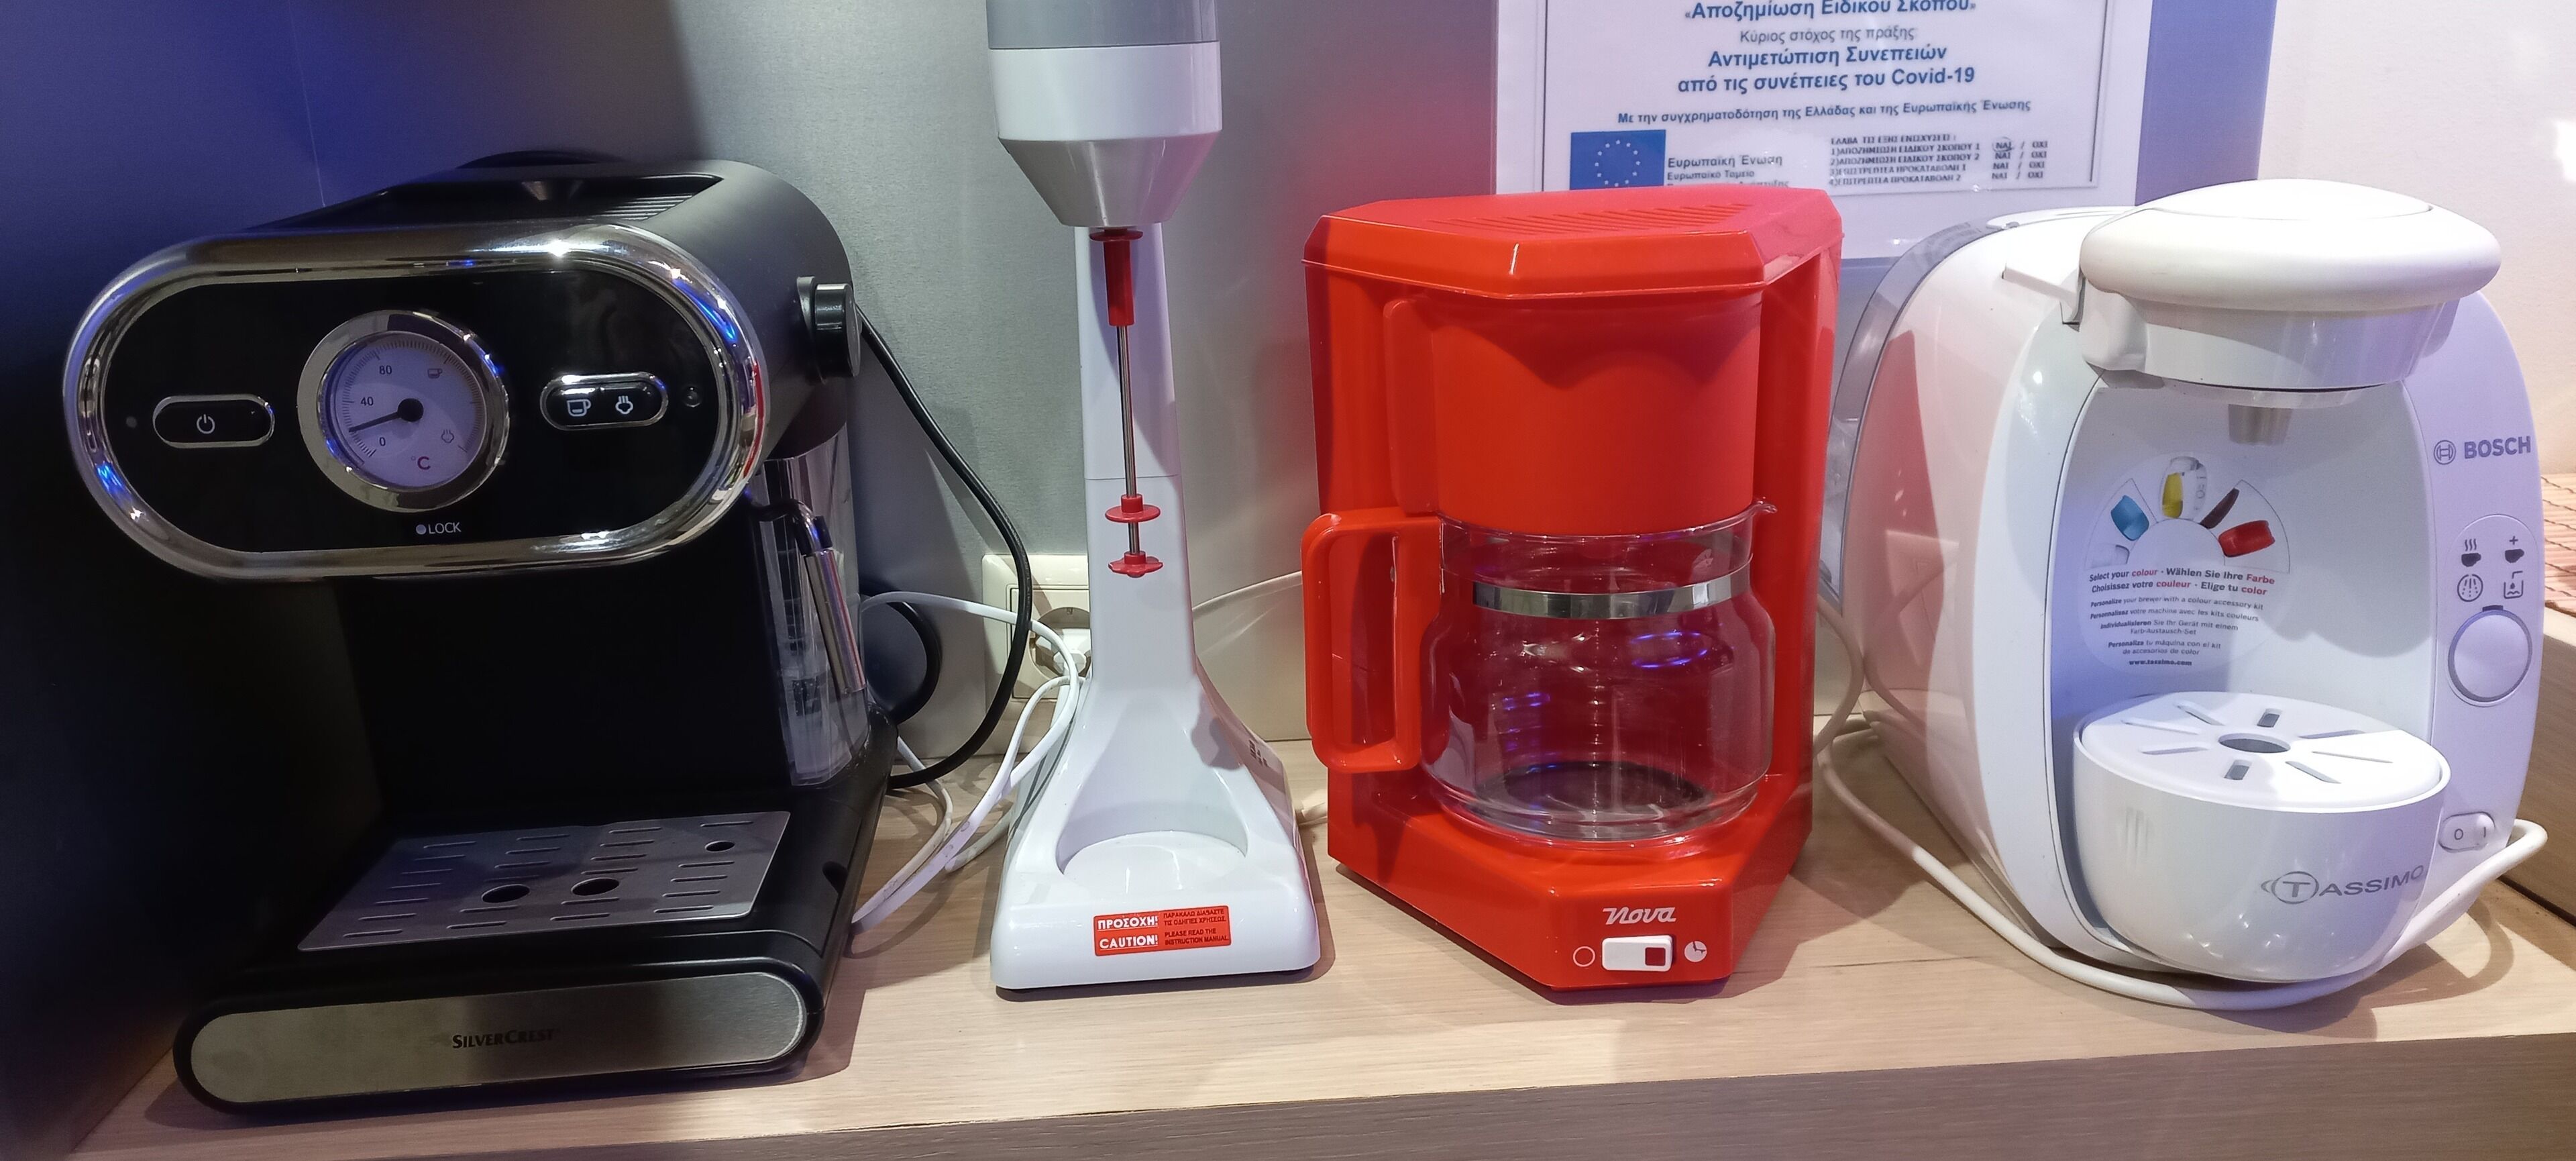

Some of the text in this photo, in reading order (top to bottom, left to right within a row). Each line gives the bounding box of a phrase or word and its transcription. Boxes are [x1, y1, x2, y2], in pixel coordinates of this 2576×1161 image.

[1739, 25, 1915, 44] Κύριος στόχος της πράξης
[1708, 43, 1947, 68] Αντιμετώπιση Συνεπειών
[1678, 66, 1974, 95] από τις συνέπειες του Covid-19
[1618, 113, 1633, 123] Με
[1638, 114, 1657, 125] την
[1782, 109, 1801, 119] της
[1805, 105, 1855, 117] Ελλάδας
[1859, 105, 1876, 115] και
[1880, 105, 1898, 116] της
[379, 365, 392, 375] 80
[360, 397, 374, 406] 40
[379, 437, 386, 446] 0
[2464, 436, 2531, 459] BOSCH
[428, 522, 462, 535] LOCK
[2089, 567, 2275, 585] Select your colour Wählen Sie Ihre Farbe
[2092, 583, 2129, 593] Choisissez
[2156, 579, 2191, 588] couleur
[2200, 581, 2225, 592] Elige
[2241, 586, 2267, 595] color
[1097, 915, 1159, 930] ΠΡΟΣΟΧΗ!
[1099, 934, 1159, 949] CAUTION!
